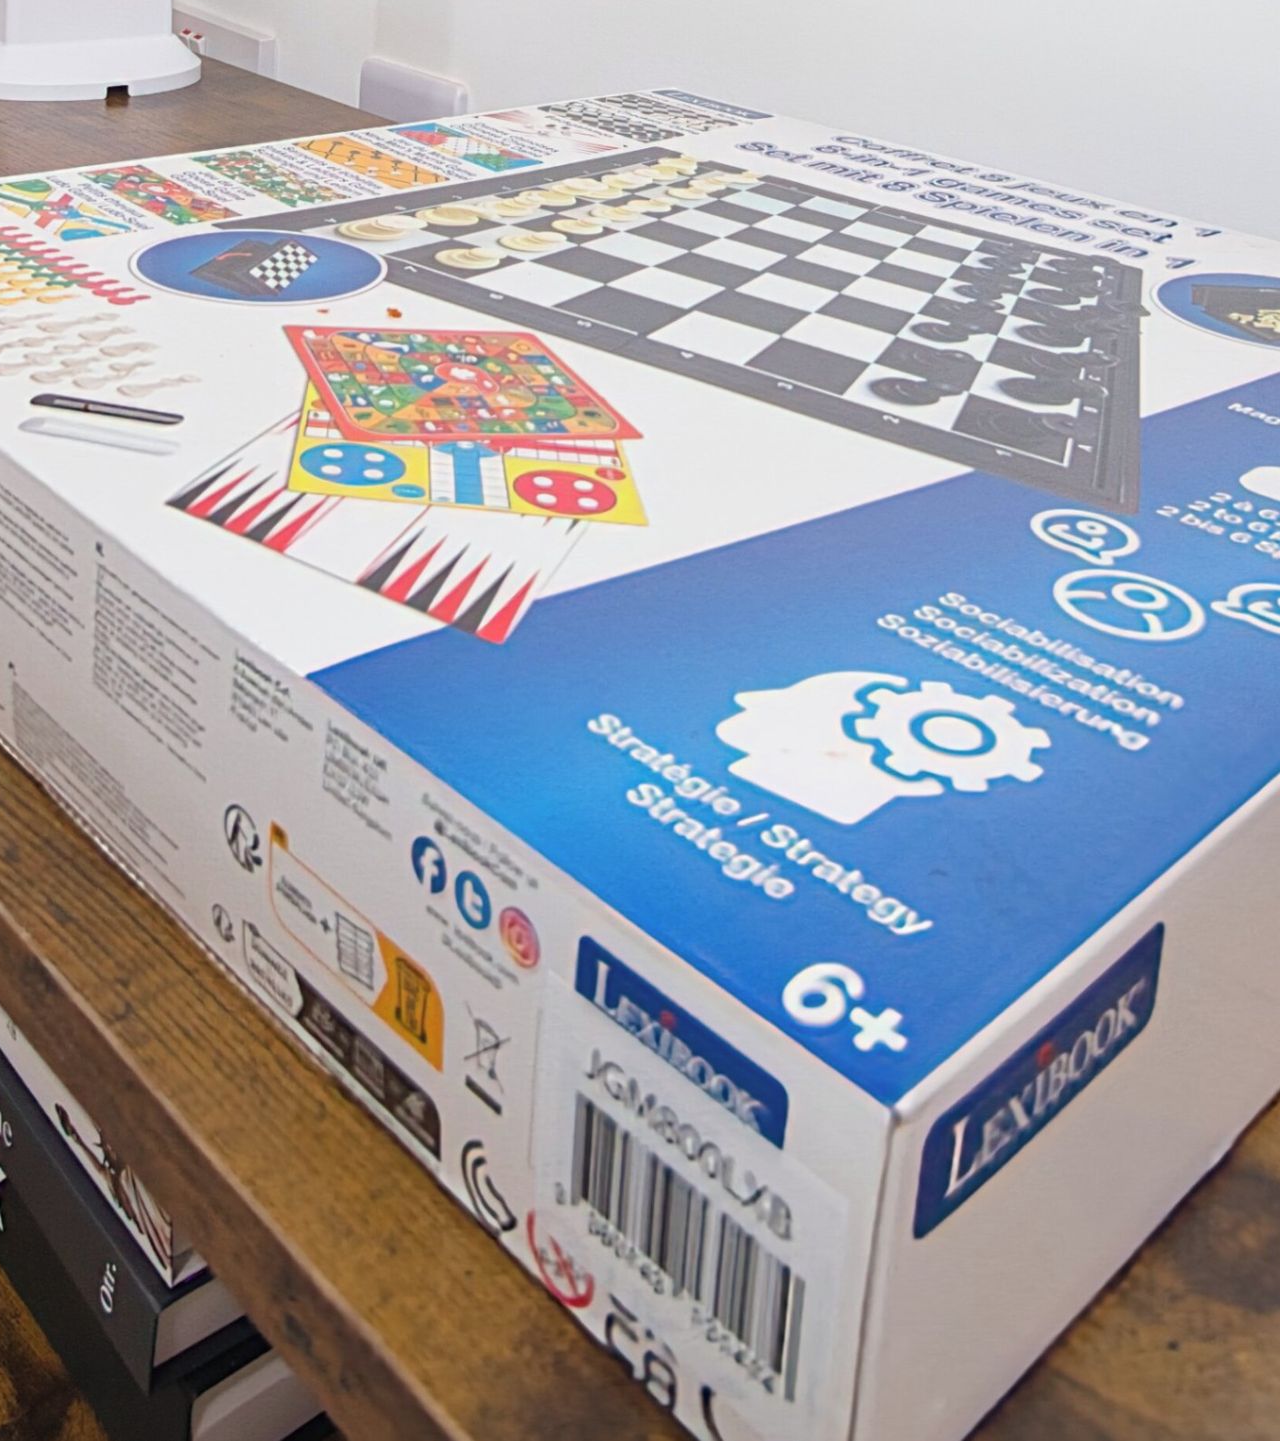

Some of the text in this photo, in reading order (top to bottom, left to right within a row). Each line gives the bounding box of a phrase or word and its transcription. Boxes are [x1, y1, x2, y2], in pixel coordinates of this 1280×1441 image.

[735, 141, 811, 163] Set
[804, 161, 882, 183] mit
[877, 179, 920, 192] 8
[914, 190, 1093, 243] Spielen
[1095, 239, 1149, 258] in
[925, 178, 1086, 220] games
[1088, 218, 1173, 244] set
[977, 170, 1013, 184] 8
[997, 182, 1113, 210] jeux
[1116, 210, 1178, 227] en
[1156, 505, 1180, 517] 2
[1180, 513, 1225, 535] bis
[1229, 532, 1252, 544] 6
[1188, 500, 1211, 511] 2
[1213, 508, 1243, 525] to
[1247, 521, 1270, 533] 6
[1209, 492, 1232, 503] 2
[1258, 509, 1280, 521] 6
[876, 613, 1150, 751] Soziabilisierung
[913, 605, 1160, 726] Sociabilization
[937, 592, 1184, 709] Sociabilisation
[587, 713, 933, 936] Stratégie / Strategy
[626, 783, 795, 900] Strategie
[781, 962, 908, 1052] 6+
[943, 977, 1147, 1199] LEXIBOOK
[100, 1262, 117, 1313] Orr.
